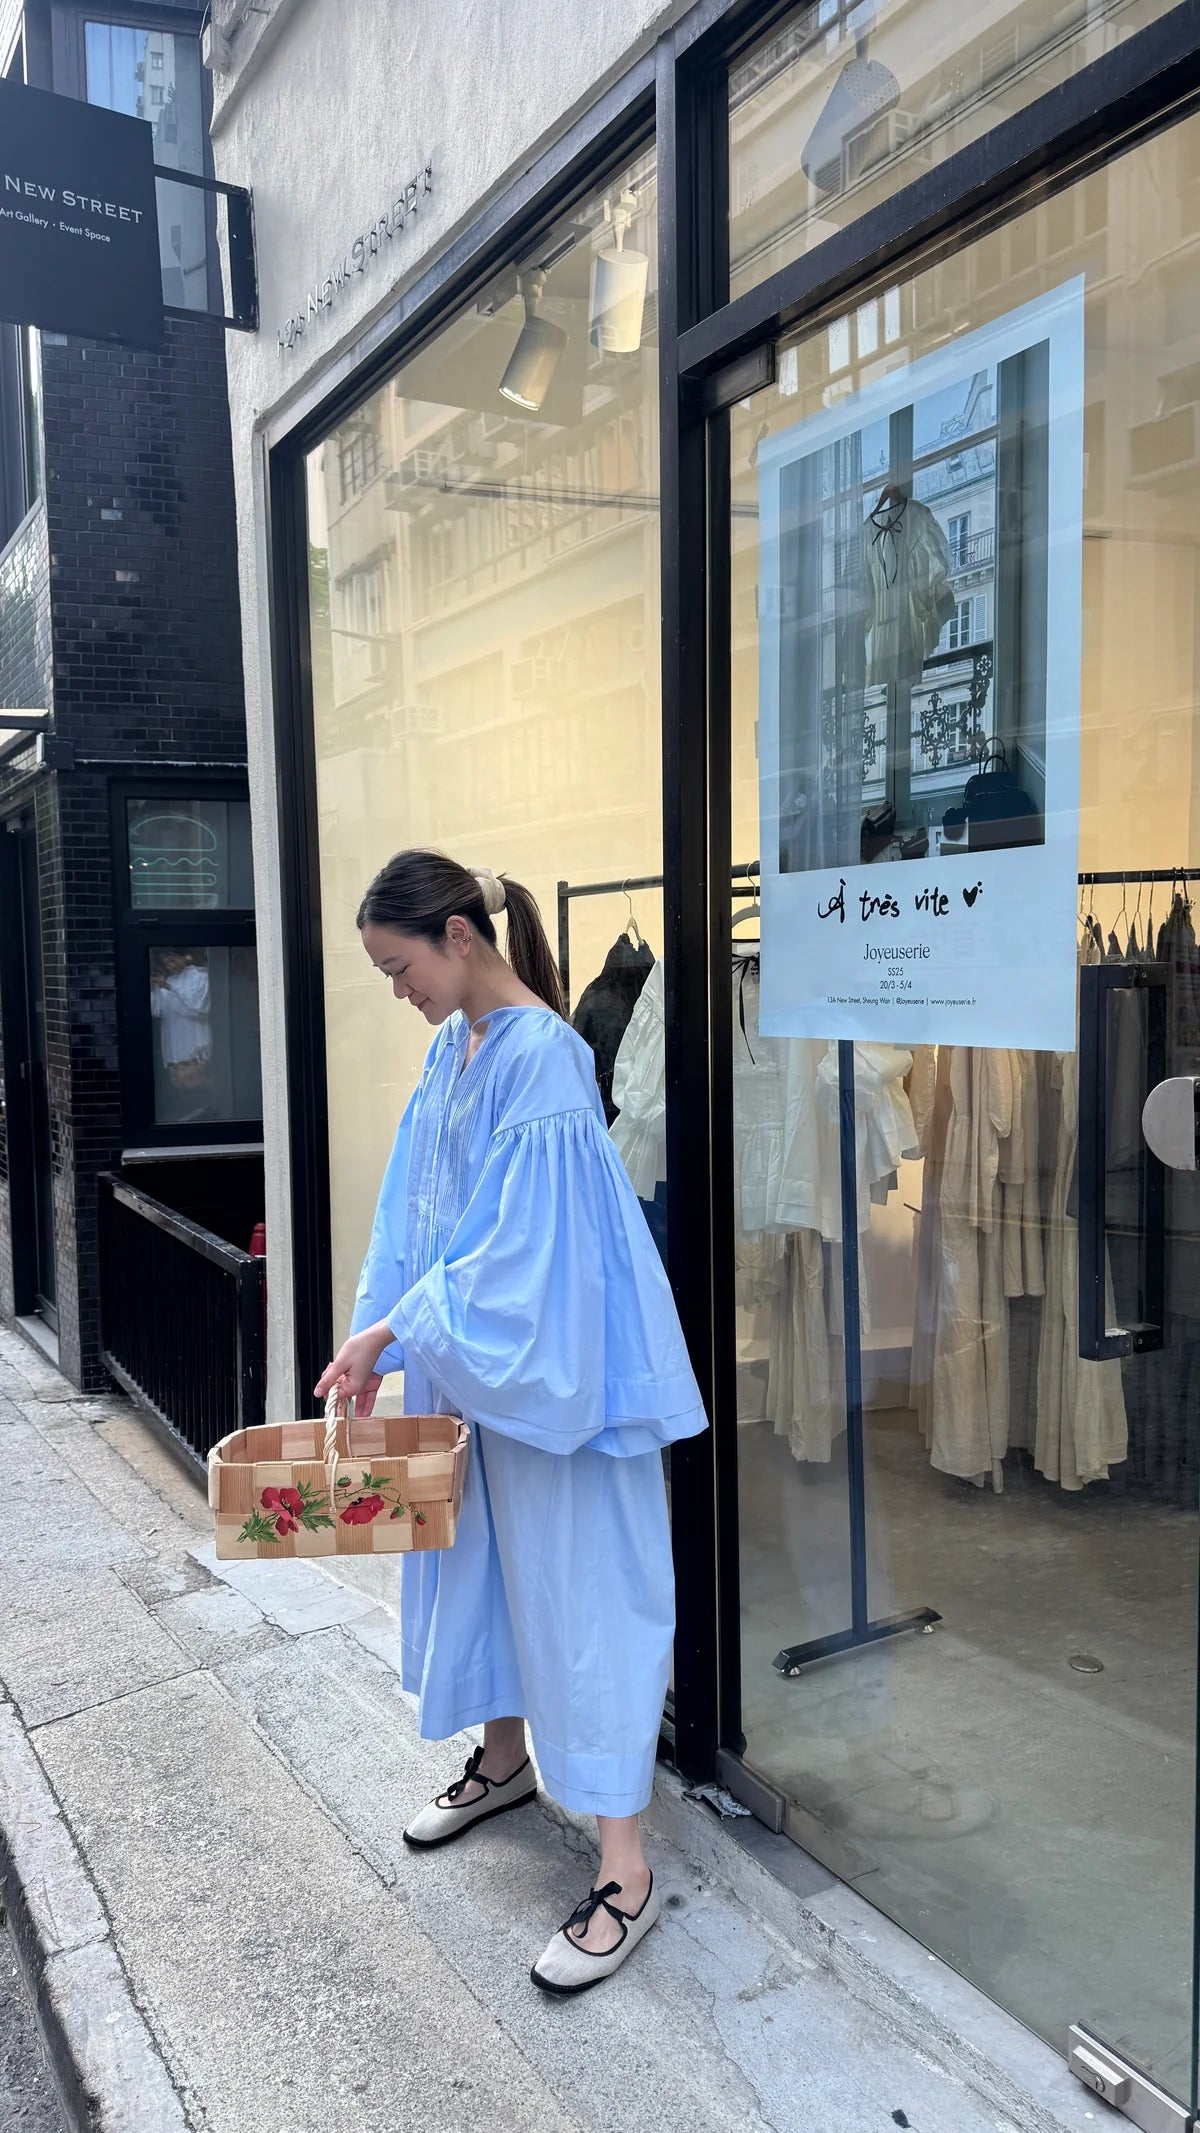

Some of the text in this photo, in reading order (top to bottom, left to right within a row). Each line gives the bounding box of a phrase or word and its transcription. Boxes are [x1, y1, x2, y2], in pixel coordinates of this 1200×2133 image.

[4, 174, 143, 224] NEW STREET
[0, 207, 111, 243] Art Gallery Event Space
[858, 890, 900, 922] très
[914, 886, 950, 917] vite
[863, 943, 931, 964] Joyeuserie
[887, 967, 904, 976] SS25
[836, 996, 847, 1004] New
[862, 996, 879, 1006] Sheung
[930, 997, 977, 1007] www.joyeuserie.fr
